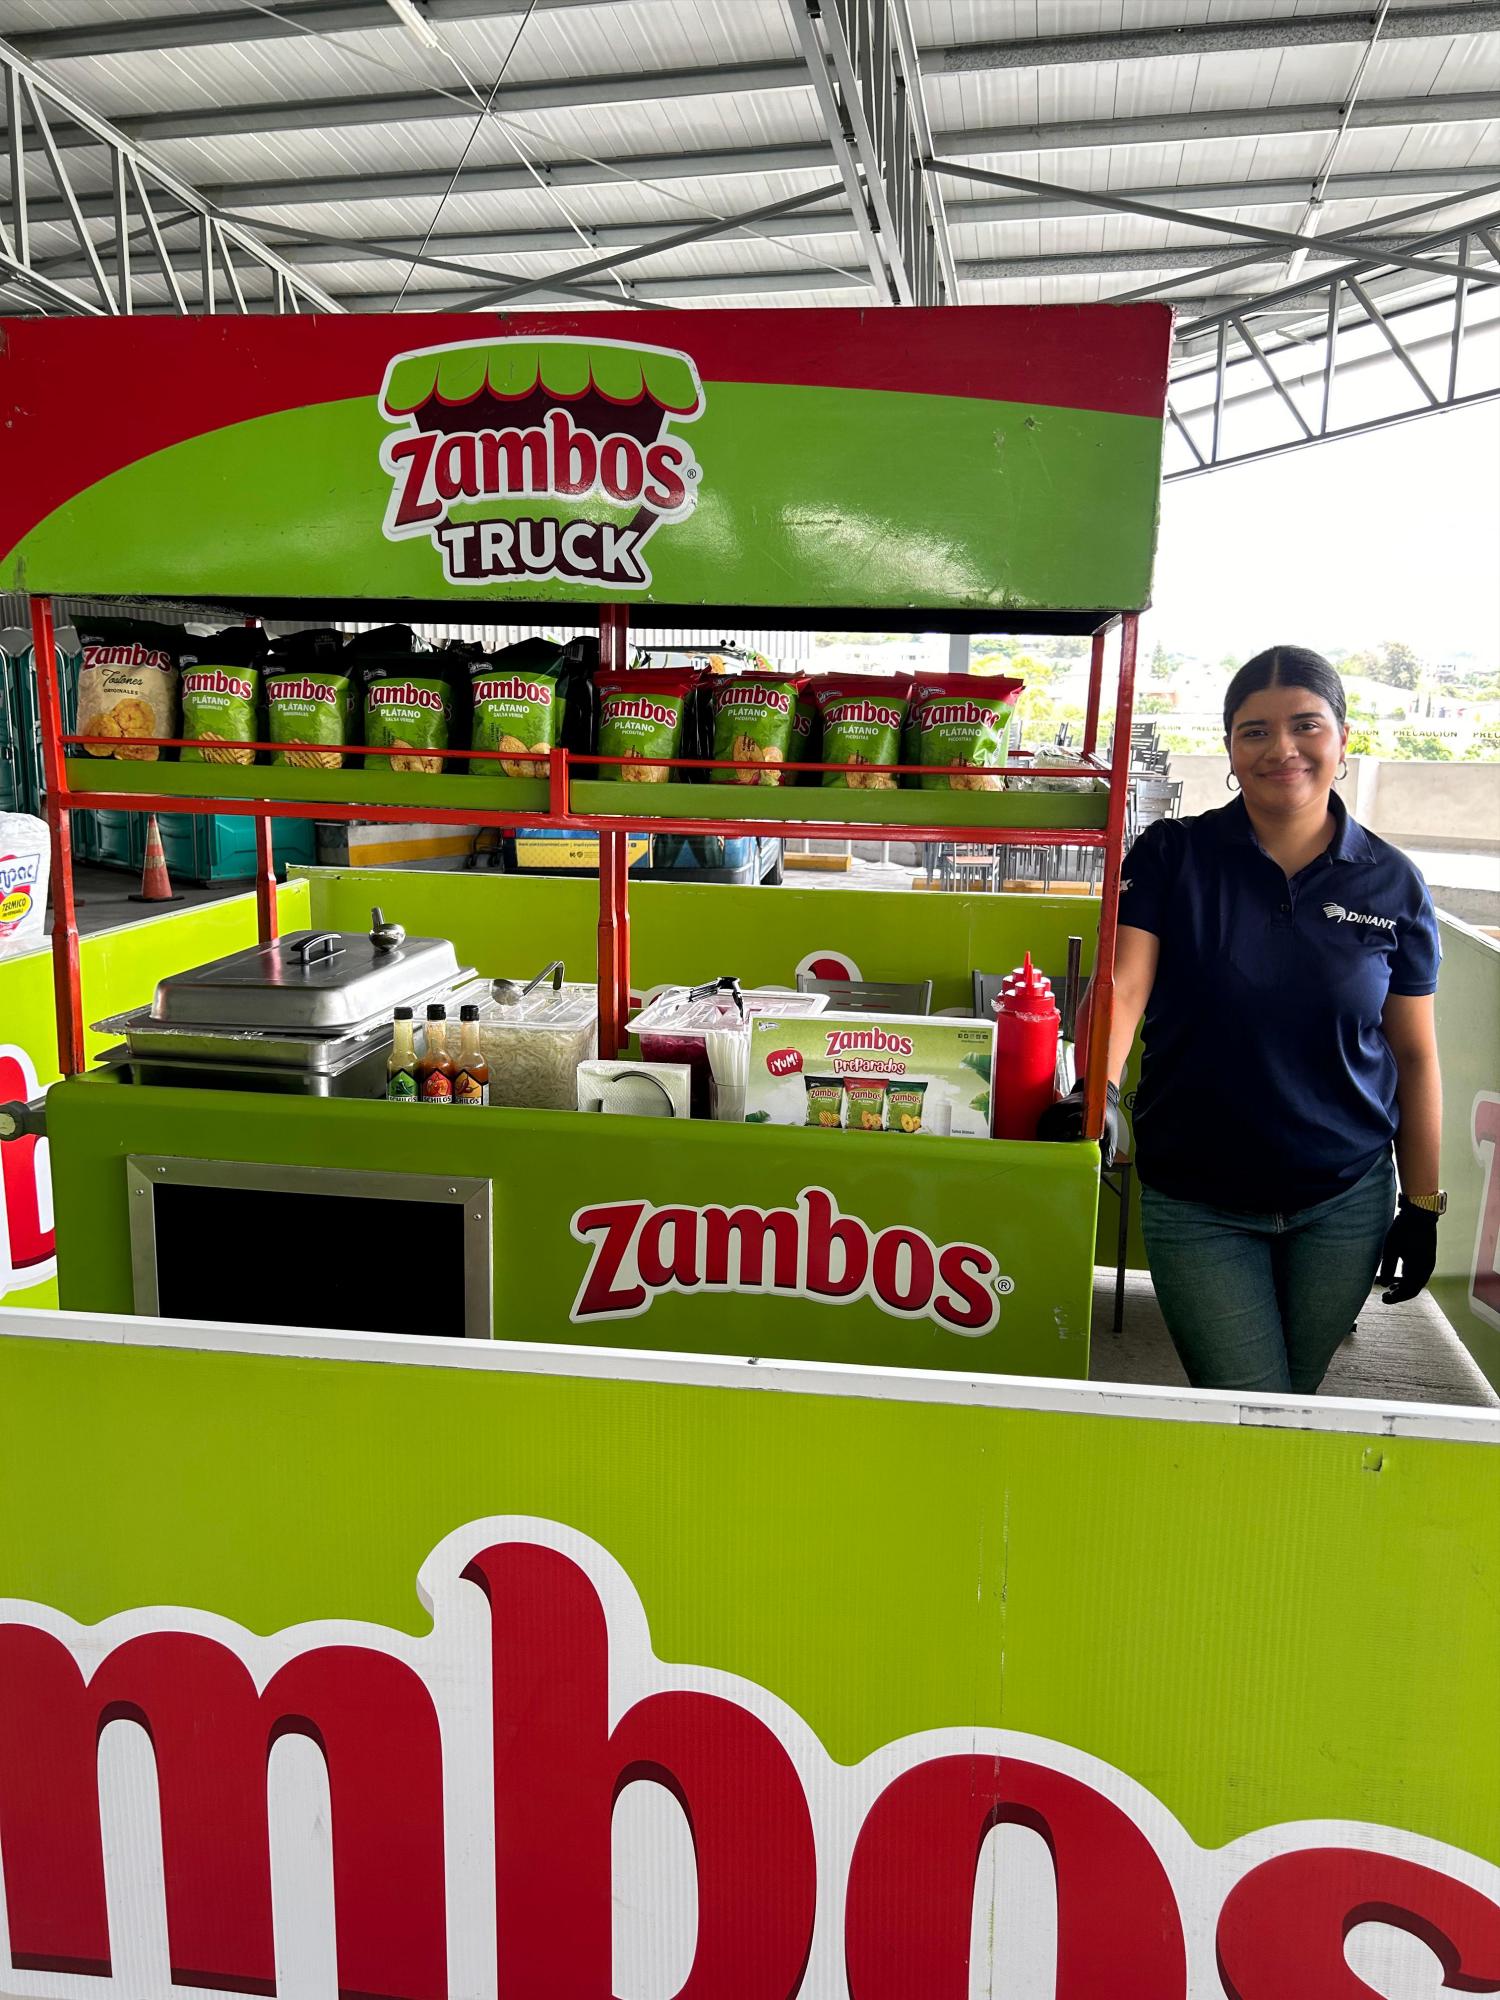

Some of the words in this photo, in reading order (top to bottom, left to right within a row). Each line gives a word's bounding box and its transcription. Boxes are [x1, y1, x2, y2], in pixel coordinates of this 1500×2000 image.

[390, 411, 686, 527] Zambos
[441, 520, 643, 580] TRUCK
[82, 642, 172, 673] Zambos
[101, 668, 144, 688] Tostones
[192, 694, 231, 706] PLÁTANO
[277, 701, 316, 712] PLÁTANO
[380, 707, 421, 719] PLÁTANO
[488, 702, 530, 714] PLÁTANO
[727, 706, 768, 718] PLÁTANO
[614, 720, 655, 733] PLÁTANO
[837, 724, 879, 736] PLÁTANO
[939, 726, 982, 737] PLÁTANO
[1346, 911, 1397, 930] DINANT
[826, 1027, 912, 1056] Zambos
[576, 1190, 994, 1329] Zambos
